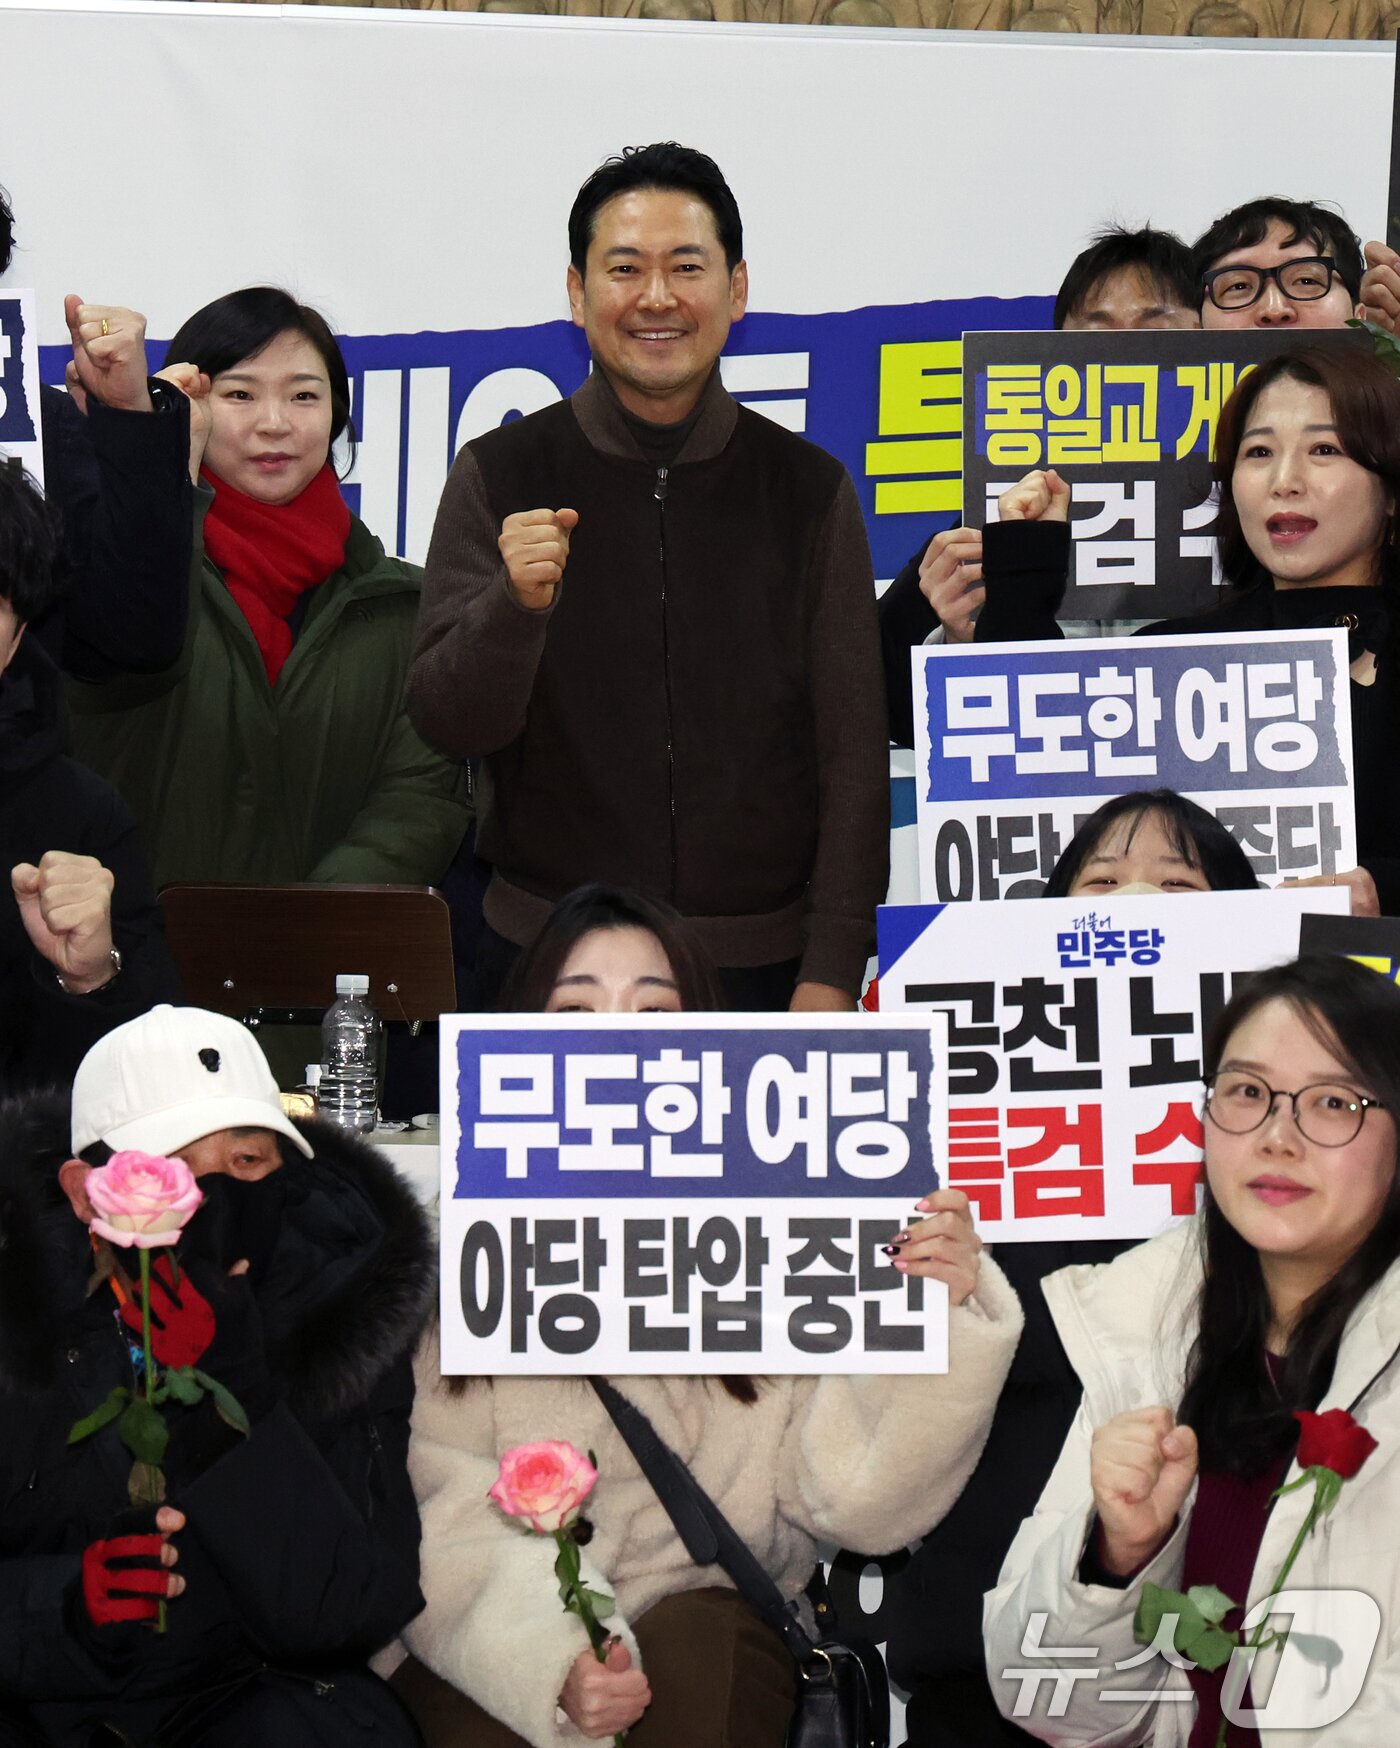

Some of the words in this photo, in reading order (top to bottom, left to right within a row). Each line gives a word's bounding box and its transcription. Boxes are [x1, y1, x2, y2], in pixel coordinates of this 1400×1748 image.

[984, 363, 1161, 466] 통일교
[985, 480, 1156, 587] 검
[942, 665, 1162, 783] 무도한
[1174, 660, 1323, 773] 여당
[1056, 928, 1165, 968] 민주당
[1072, 911, 1111, 933] 더불어
[904, 976, 1103, 1095] 공천
[473, 1048, 732, 1179] 무도한
[745, 1050, 918, 1180] 여당
[459, 1216, 607, 1355] 야당
[623, 1215, 770, 1353] 탄압
[783, 1216, 925, 1354] 중단
